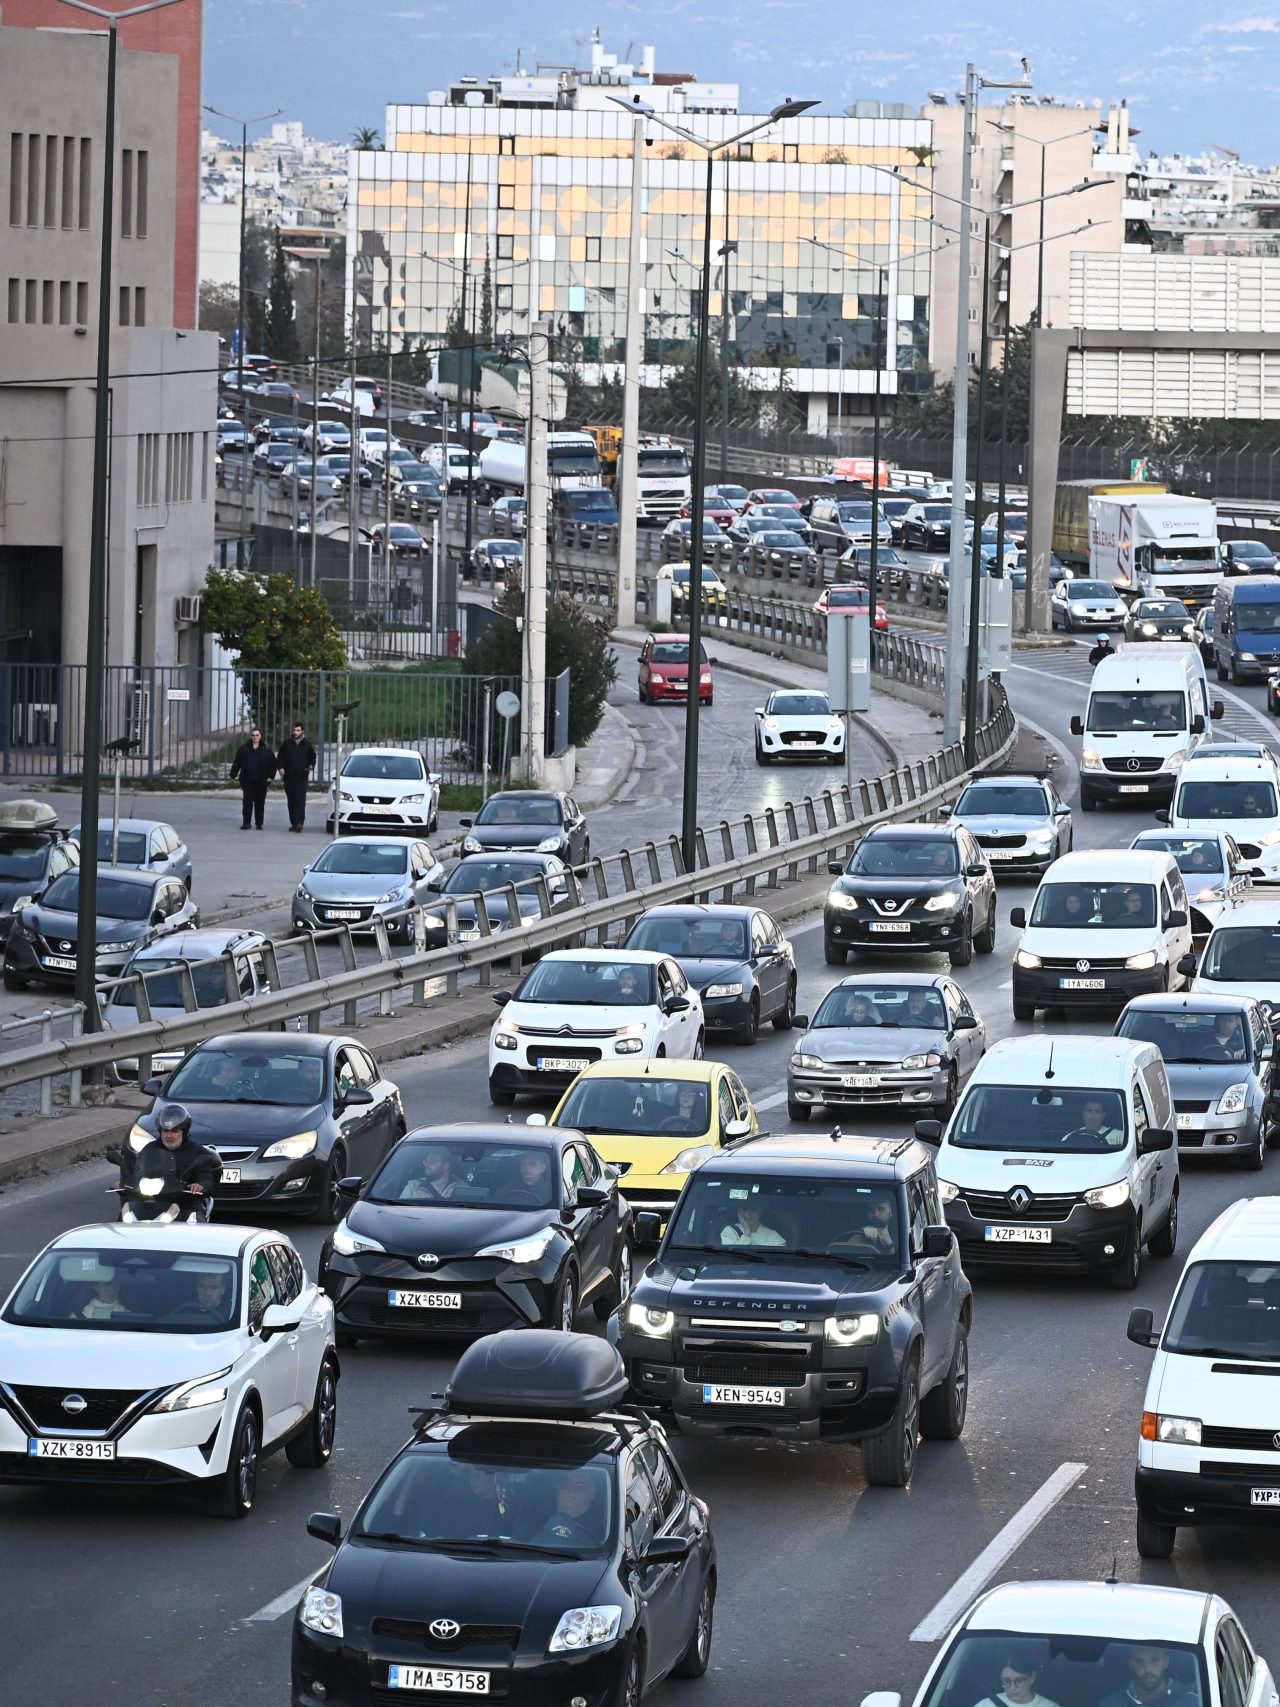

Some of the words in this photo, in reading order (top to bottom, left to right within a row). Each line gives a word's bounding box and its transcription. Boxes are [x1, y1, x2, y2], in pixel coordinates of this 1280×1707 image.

[995, 1229, 1049, 1241] XZP-1431
[400, 1294, 459, 1308] XZK-6504
[693, 1299, 808, 1310] DEFENDER
[715, 1388, 782, 1403] XEN-9549
[42, 1441, 113, 1458] XZK-8915
[405, 1669, 487, 1691] IMA-5158
